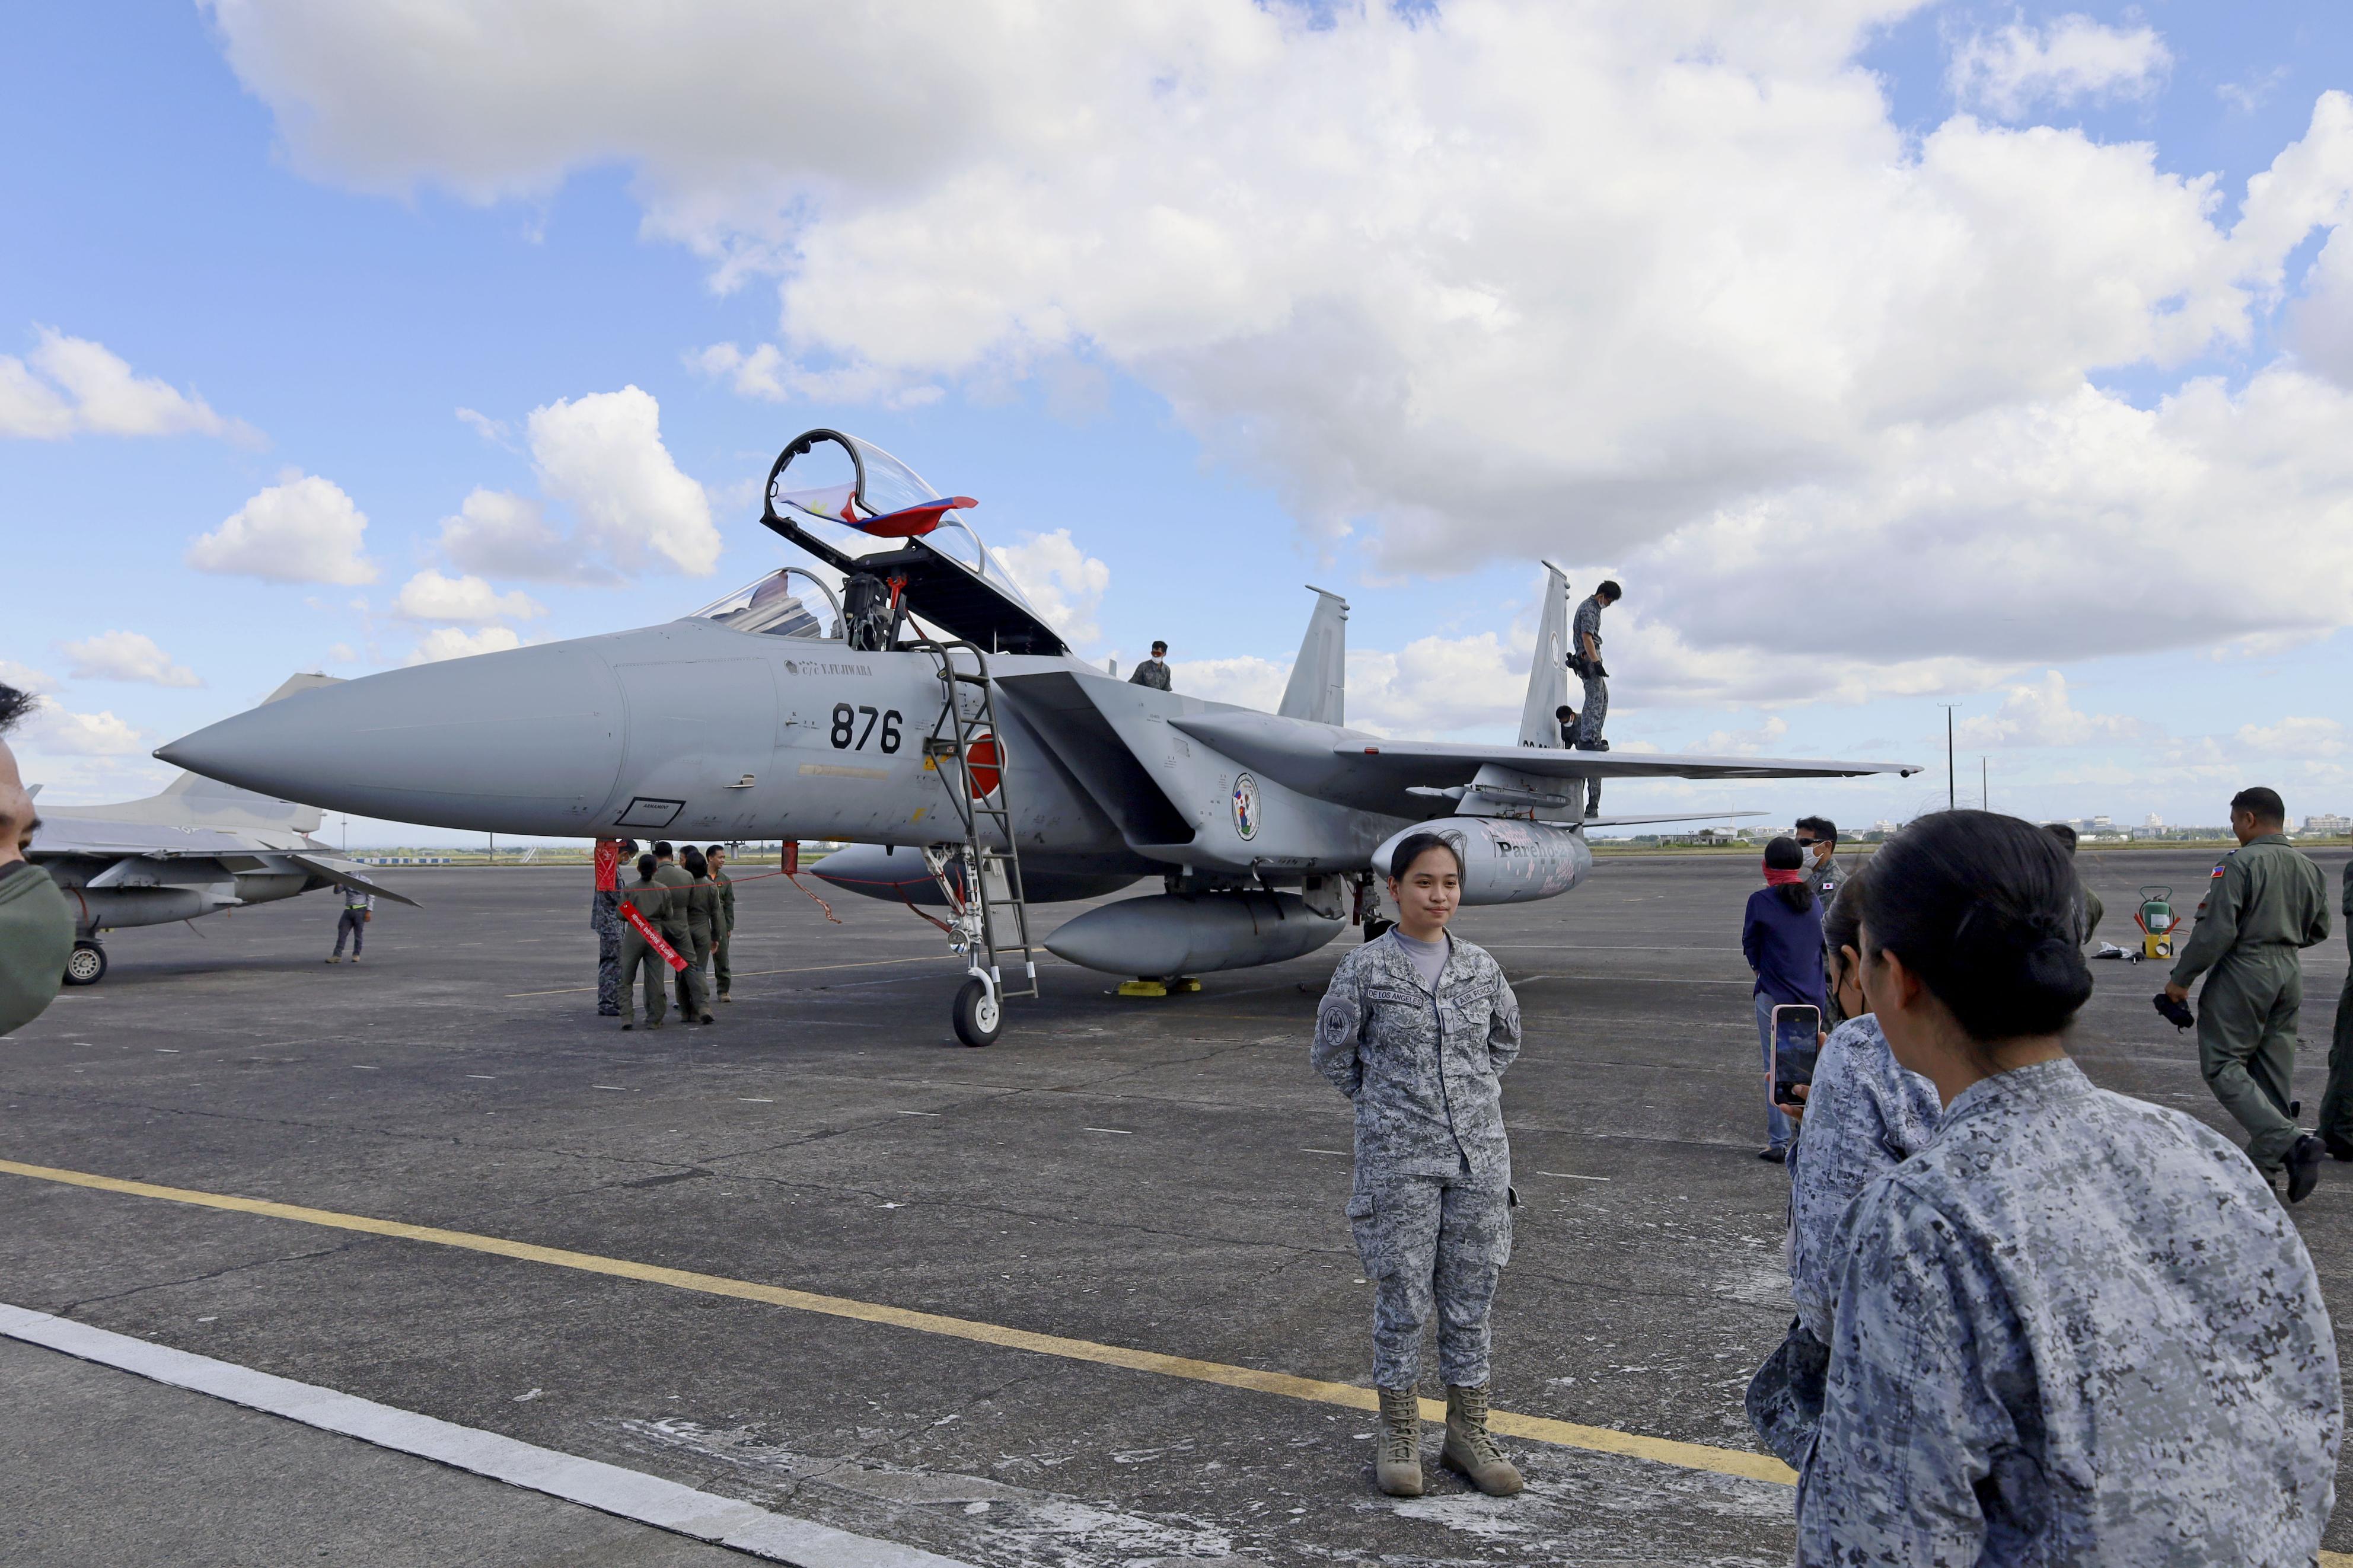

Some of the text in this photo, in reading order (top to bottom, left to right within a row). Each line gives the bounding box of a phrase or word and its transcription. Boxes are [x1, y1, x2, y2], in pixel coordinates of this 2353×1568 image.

[821, 663, 872, 676] Y.FUJIWARA
[831, 702, 903, 754] 876
[631, 914, 674, 959] REMOVE BEFORE FLIGHT
[1392, 994, 1421, 1006] ANGELES
[1459, 985, 1493, 1005] AIR FORCE
